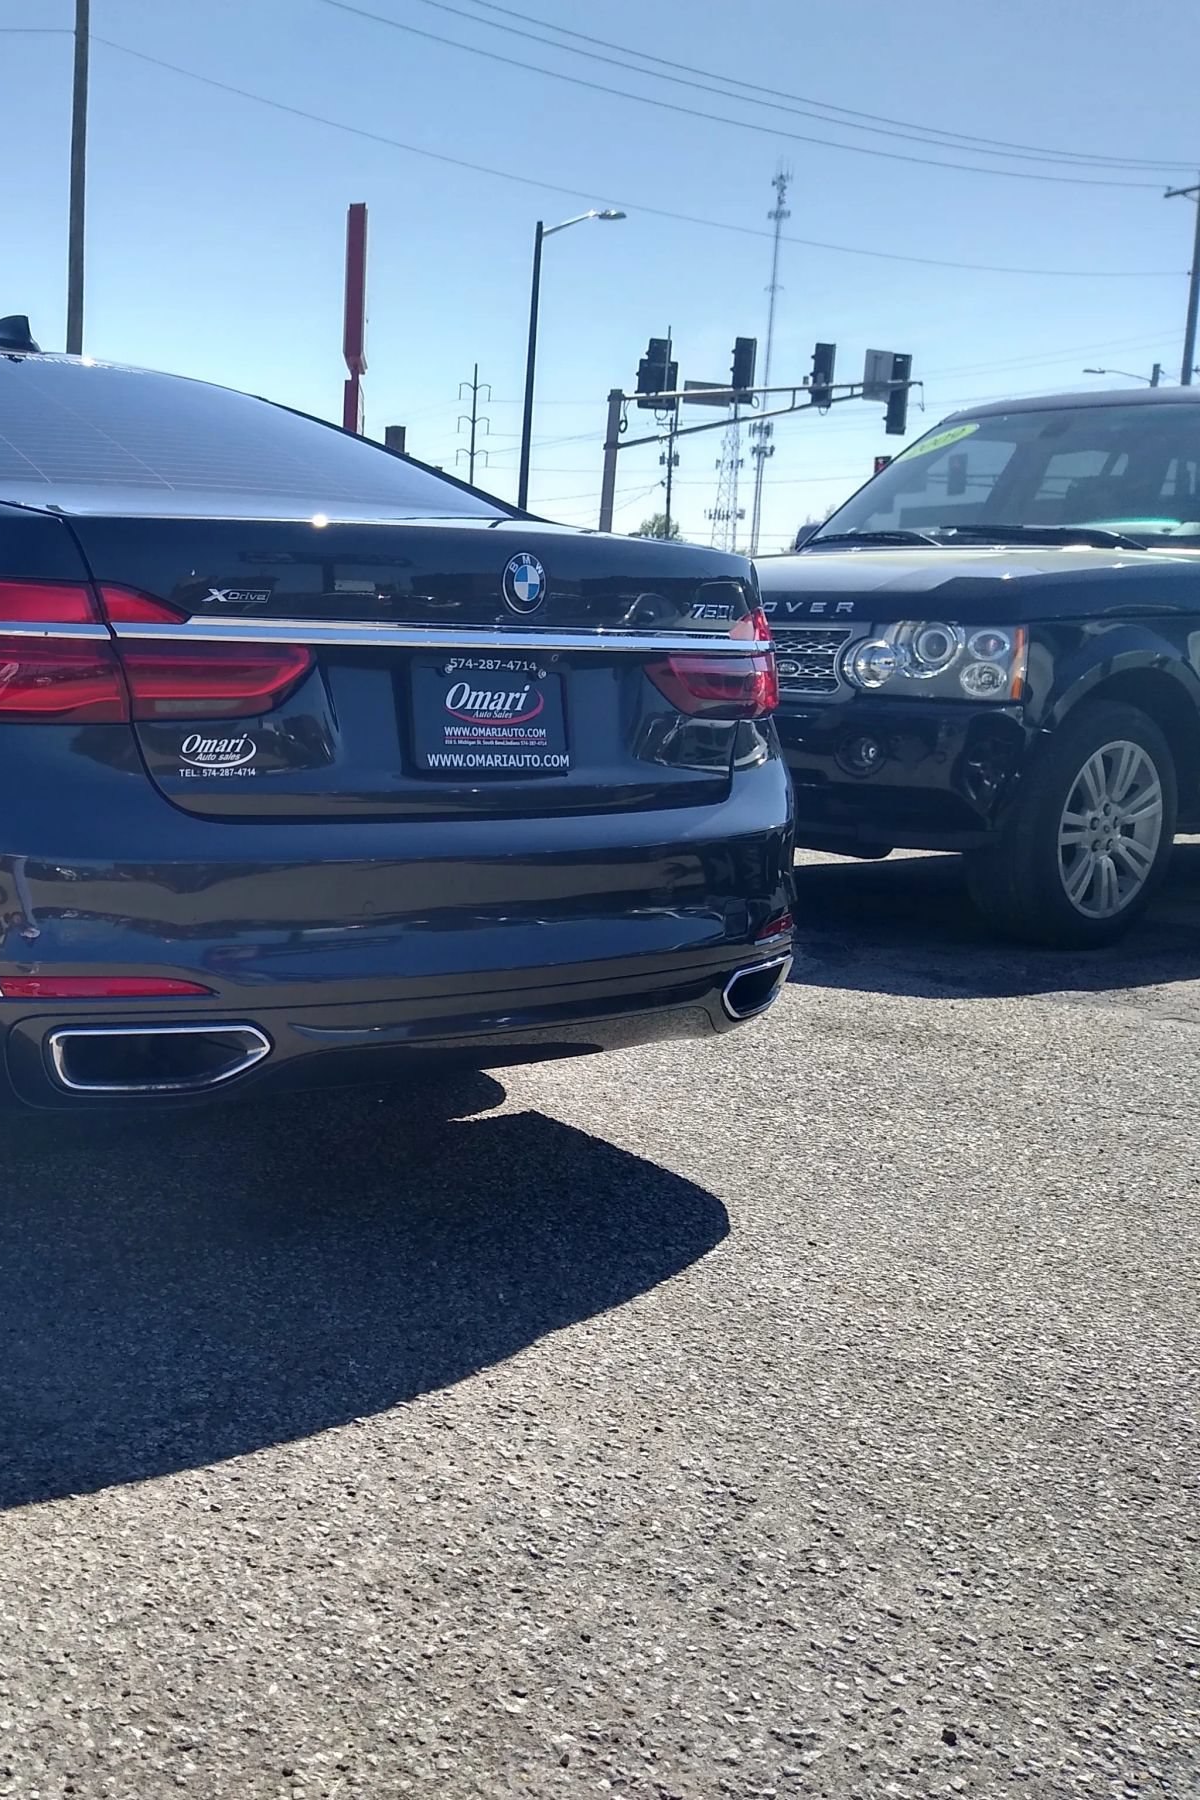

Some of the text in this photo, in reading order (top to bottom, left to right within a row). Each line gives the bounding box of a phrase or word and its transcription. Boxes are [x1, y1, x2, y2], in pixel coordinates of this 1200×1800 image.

[509, 555, 543, 574] BMW
[450, 658, 537, 671] 574-287-4714
[445, 682, 530, 711] Omari
[472, 709, 513, 719] Auto Sales
[444, 726, 547, 738] WWW.OMARIAUTO.COM
[182, 733, 248, 753] Omari
[195, 752, 241, 761] Auto sales
[427, 753, 570, 768] WWW.OMARIAUTO.COM
[202, 768, 256, 777] 574-287-4714
